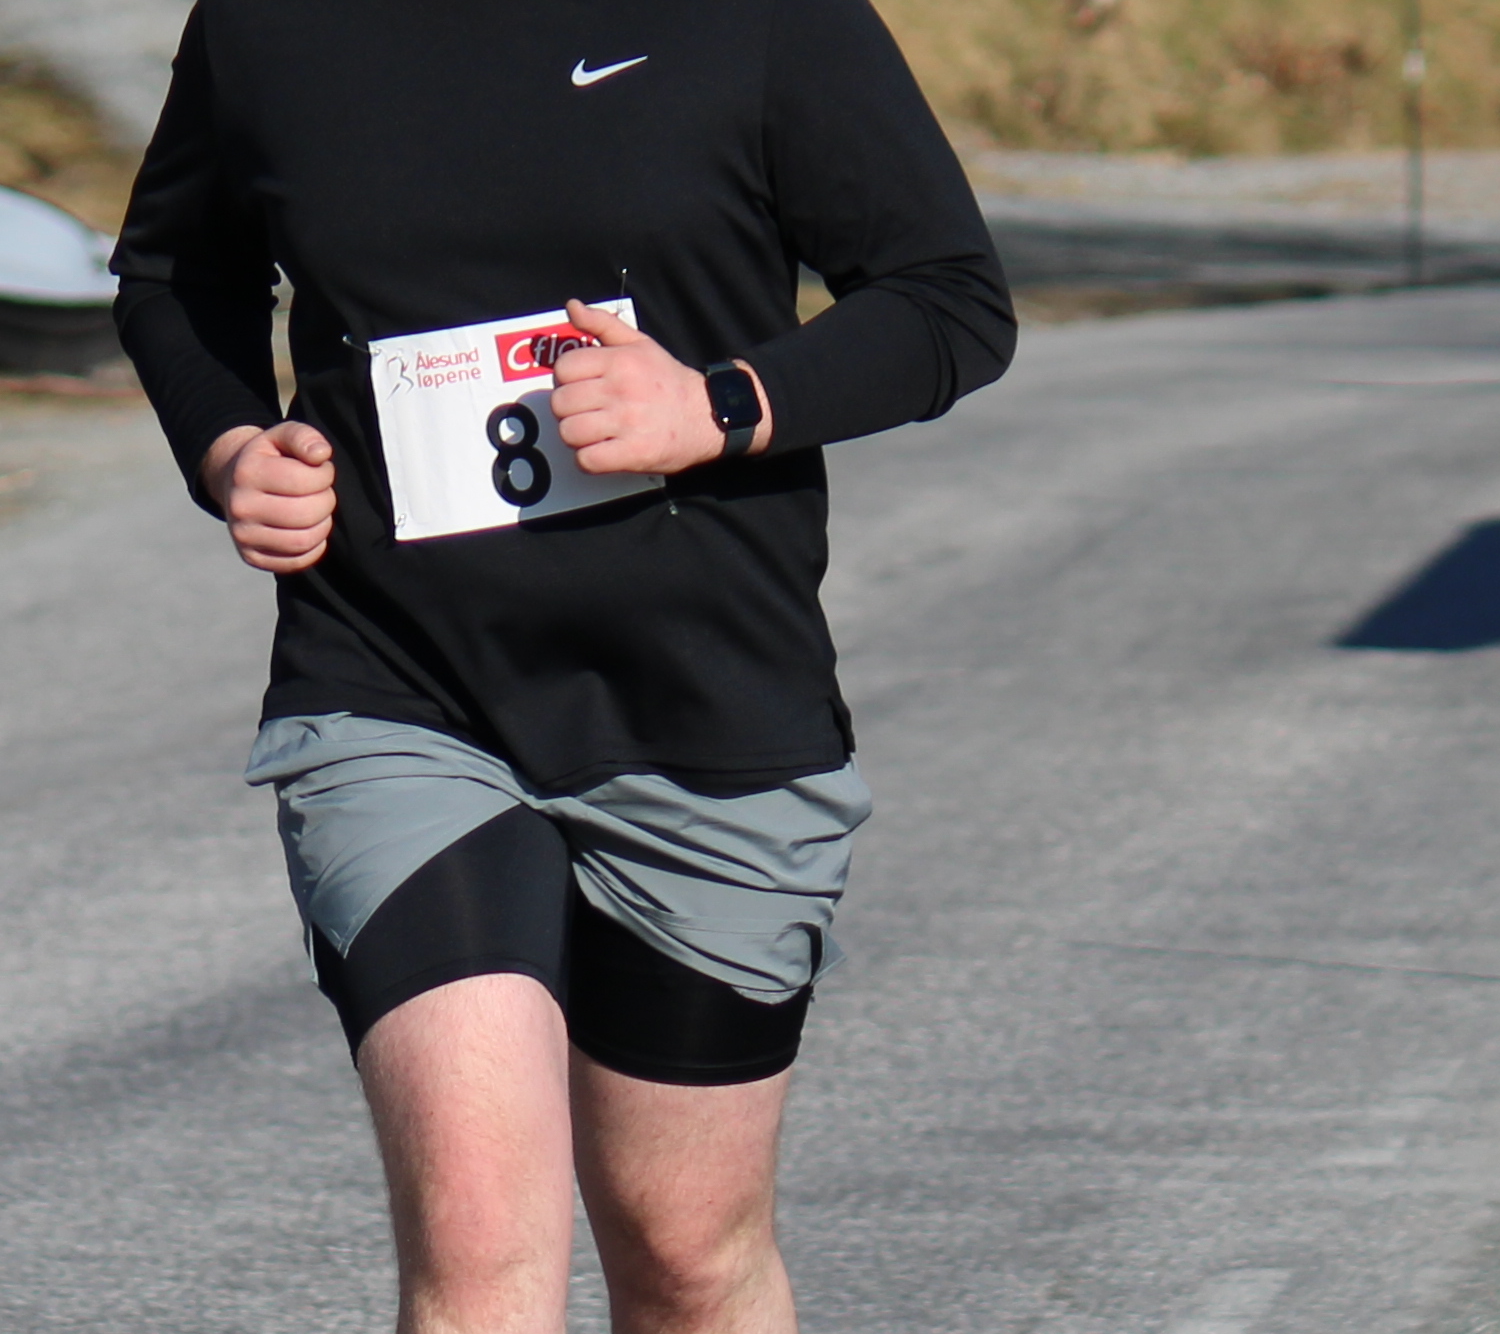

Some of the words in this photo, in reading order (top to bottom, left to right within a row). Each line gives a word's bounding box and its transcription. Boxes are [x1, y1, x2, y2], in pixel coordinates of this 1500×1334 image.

[415, 347, 480, 371] Ålesund
[417, 367, 482, 389] løpene
[486, 402, 551, 507] 8
